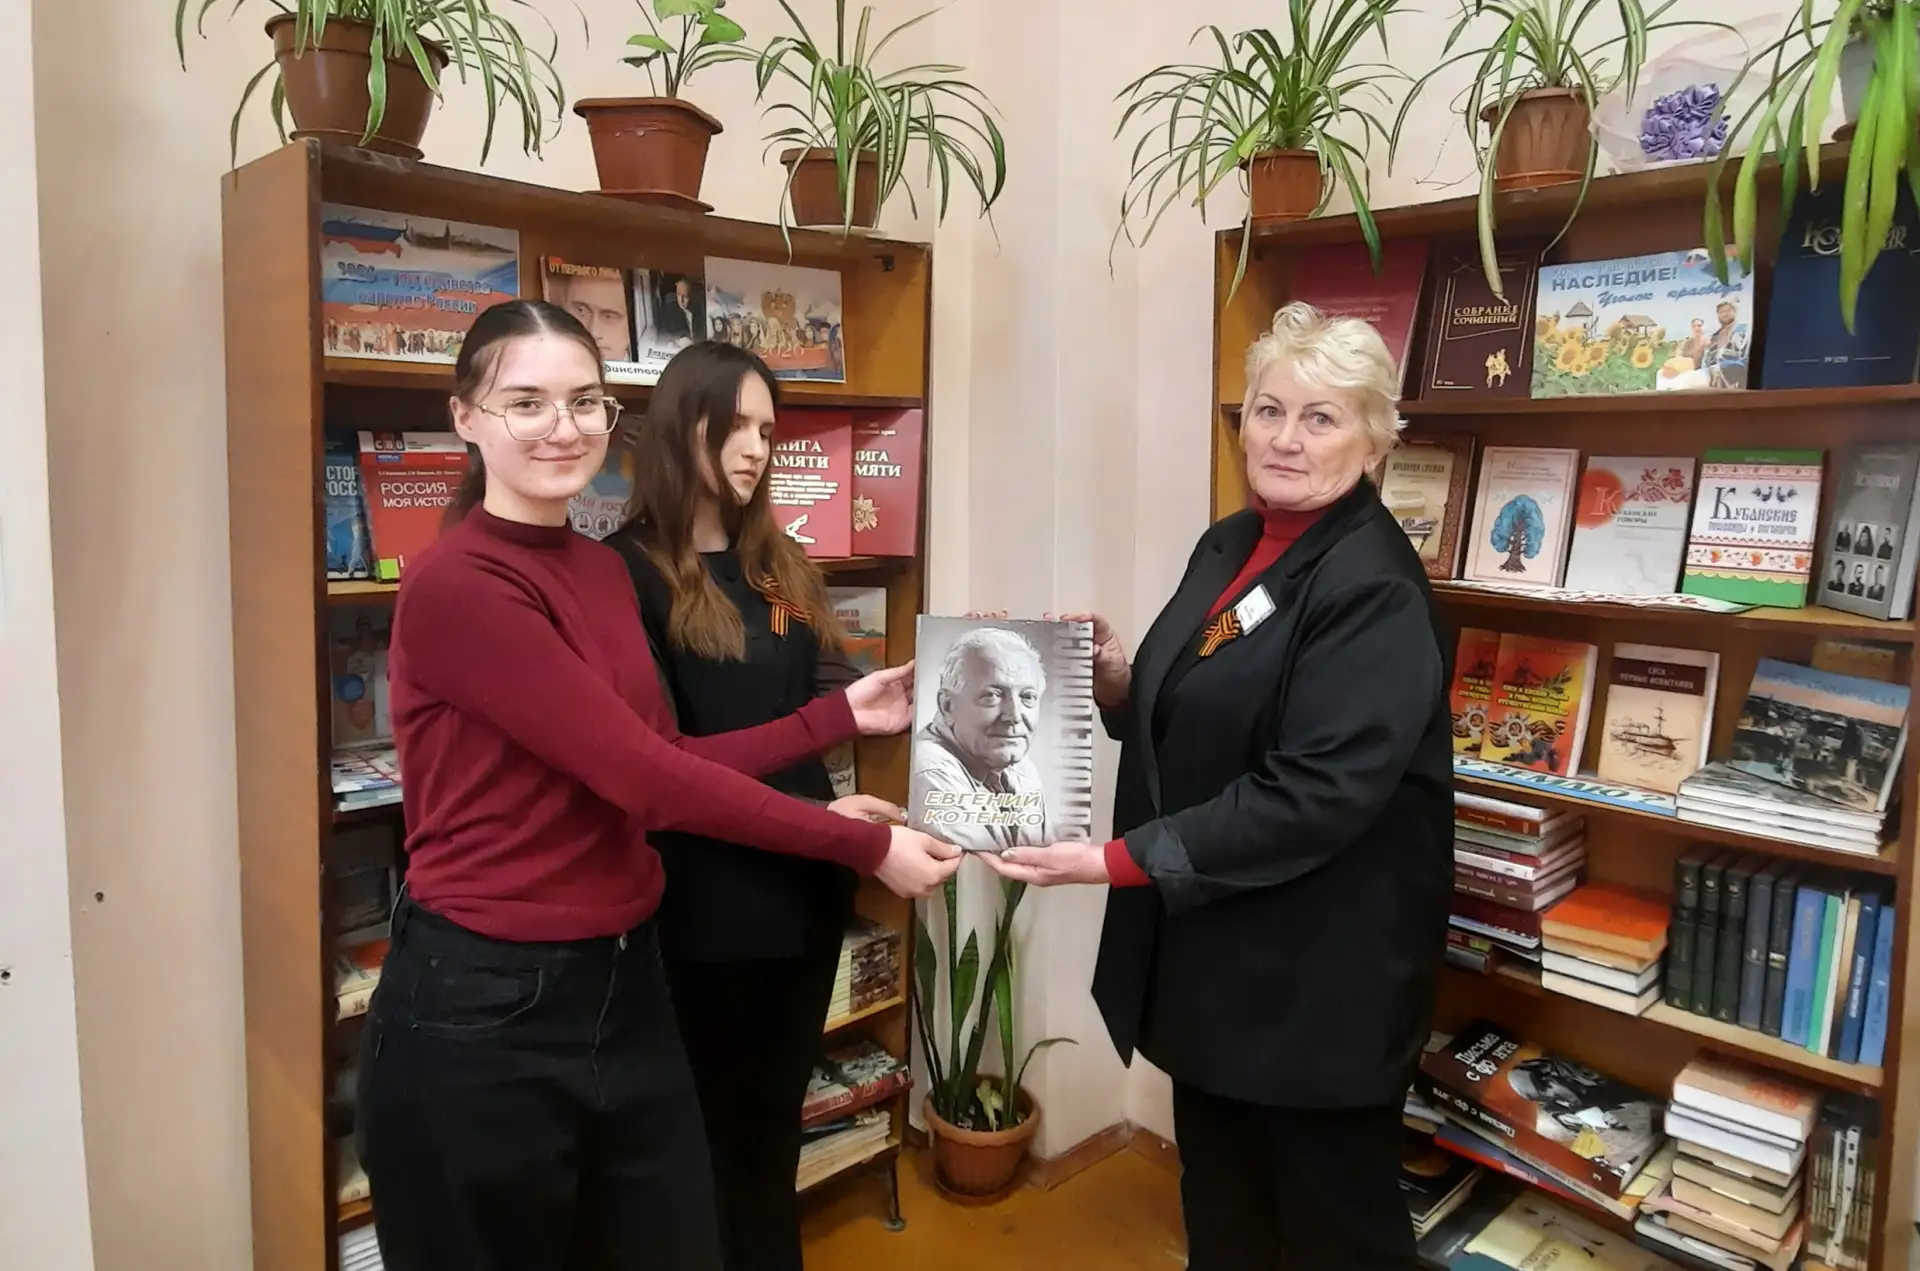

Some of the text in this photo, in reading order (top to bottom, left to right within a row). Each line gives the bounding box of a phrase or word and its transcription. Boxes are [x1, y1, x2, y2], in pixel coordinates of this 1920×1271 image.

[1552, 267, 1678, 292] НАСЛЕДИЕ!
[1597, 290, 1653, 308] Уголок
[1454, 305, 1518, 315] СОБРАНИЕ
[1453, 315, 1517, 325] СОЧИНЕНИЙ
[381, 482, 447, 495] РОССИЯ
[383, 498, 411, 508] МОЯ
[925, 790, 1043, 808] ЕВГЕНИЙ
[924, 809, 1044, 826] КОТЕНКО
[1455, 1033, 1501, 1065] Письма
